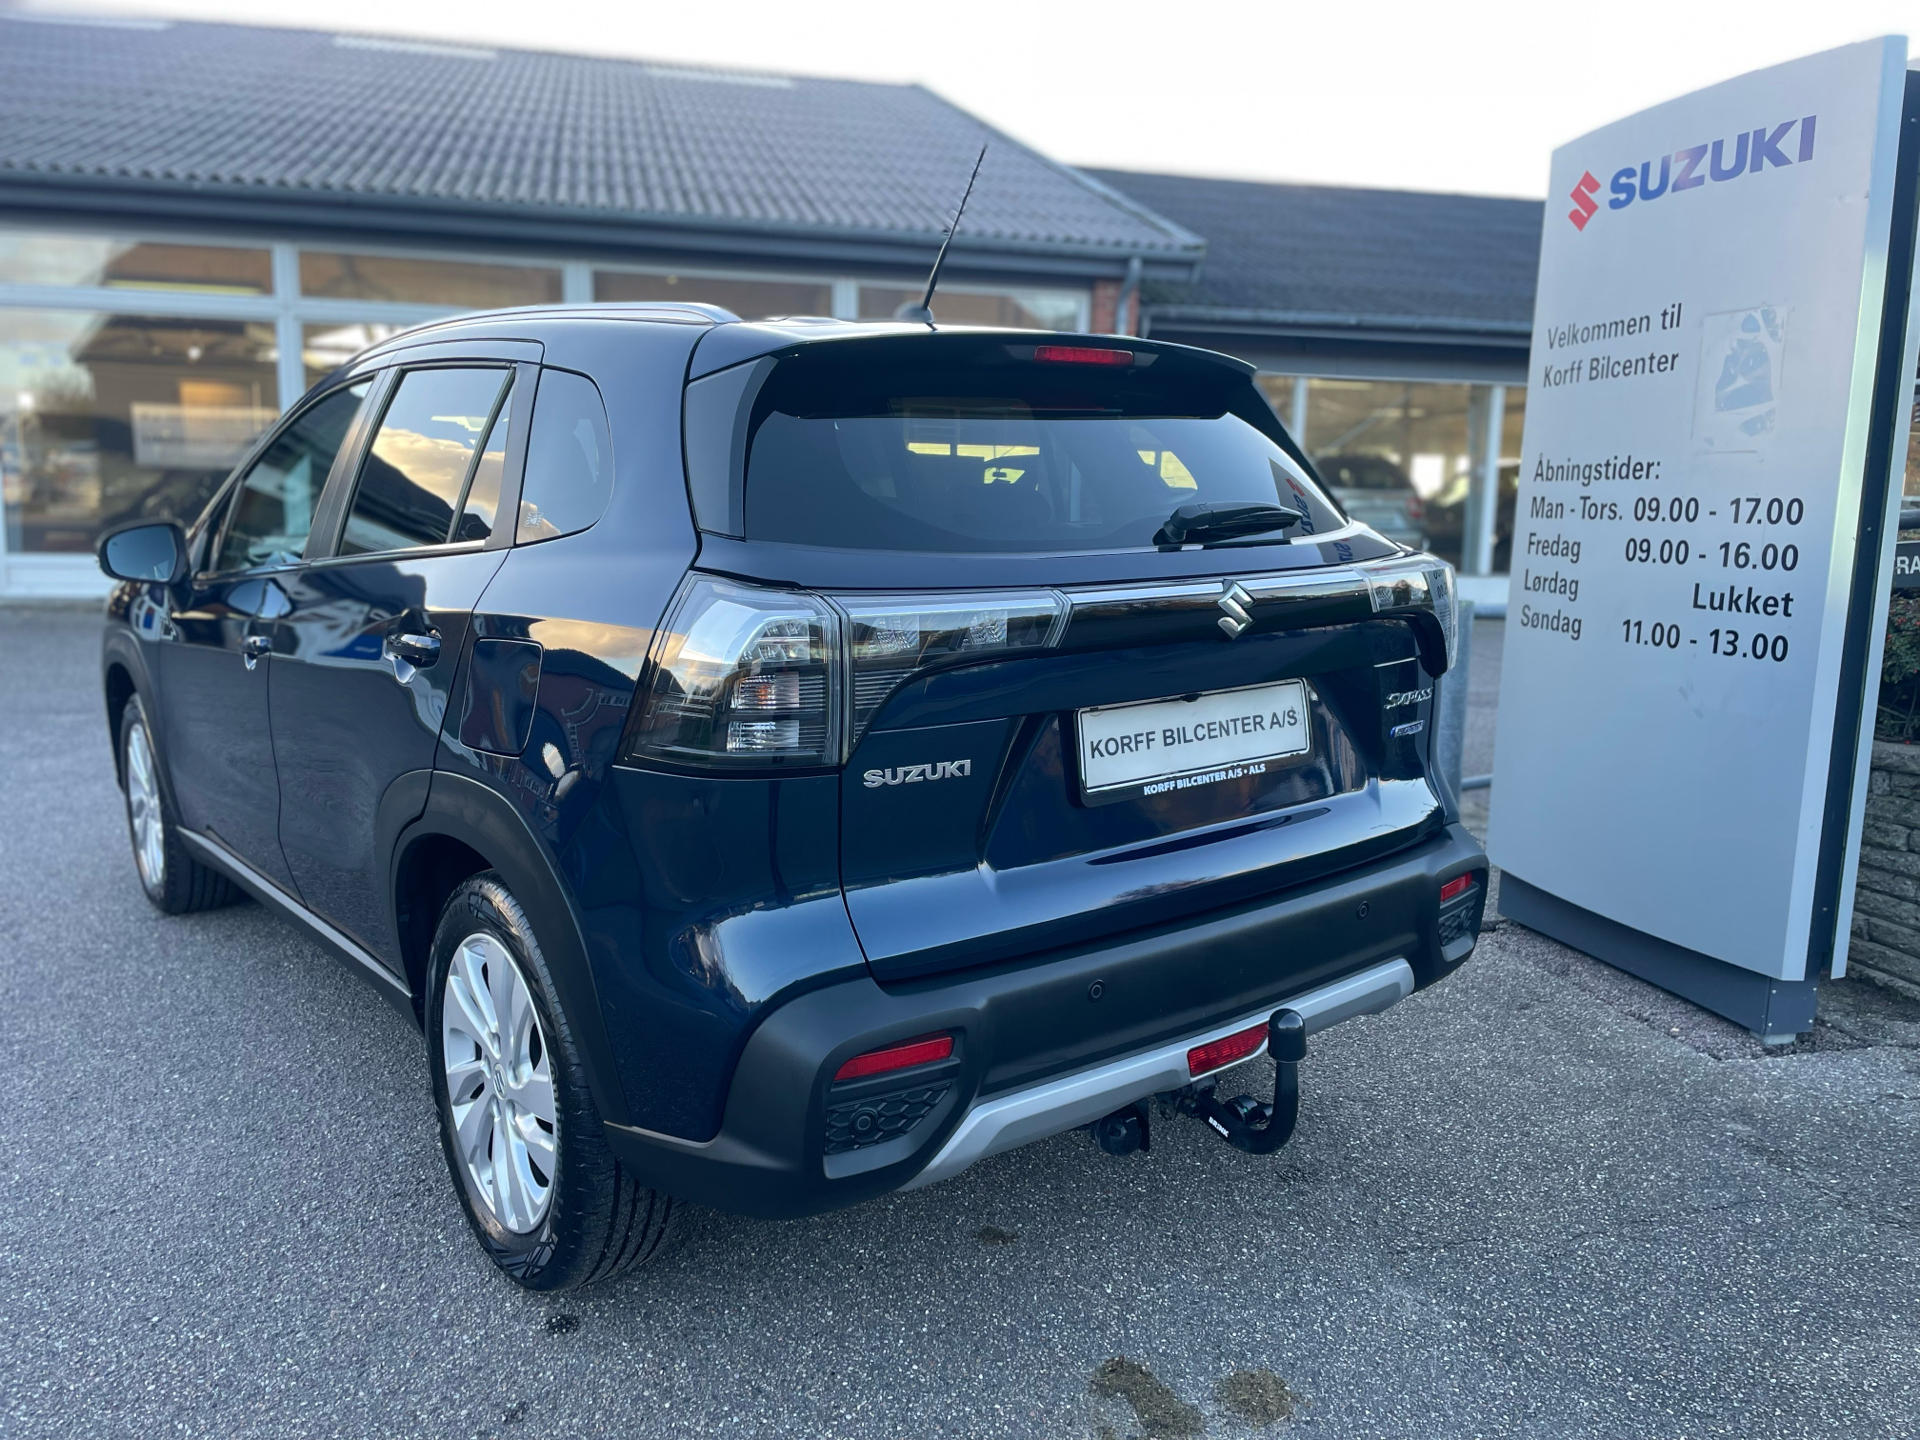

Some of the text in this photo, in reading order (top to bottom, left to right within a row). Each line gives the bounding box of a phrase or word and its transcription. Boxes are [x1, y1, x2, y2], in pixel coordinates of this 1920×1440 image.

[1608, 115, 1816, 210] SUZUKI
[1548, 303, 1682, 350] Velkommen til
[1543, 352, 1679, 388] Korff Bilcenter
[1533, 453, 1660, 487] Åbningstider:
[1530, 496, 1564, 519] Man
[1579, 496, 1622, 520] Tors.
[1634, 496, 1699, 523] 09.00
[1730, 497, 1805, 525] 17.00
[1527, 532, 1581, 564] Fredag
[1625, 538, 1689, 565] 09.00
[1718, 542, 1799, 571] 16.00
[1524, 568, 1794, 617] Lørdag Lukket
[1521, 604, 1582, 641] Søndag
[1623, 618, 1680, 649] 11.00
[1709, 629, 1789, 662] 13.00
[1090, 709, 1298, 759] KORFF BILCENTER A/S
[863, 759, 971, 788] SUZUKI
[1143, 781, 1176, 796] KORFF
[1177, 772, 1226, 789] BILCENTER
[1227, 767, 1242, 780] A/S
[1249, 763, 1266, 775] ALS
